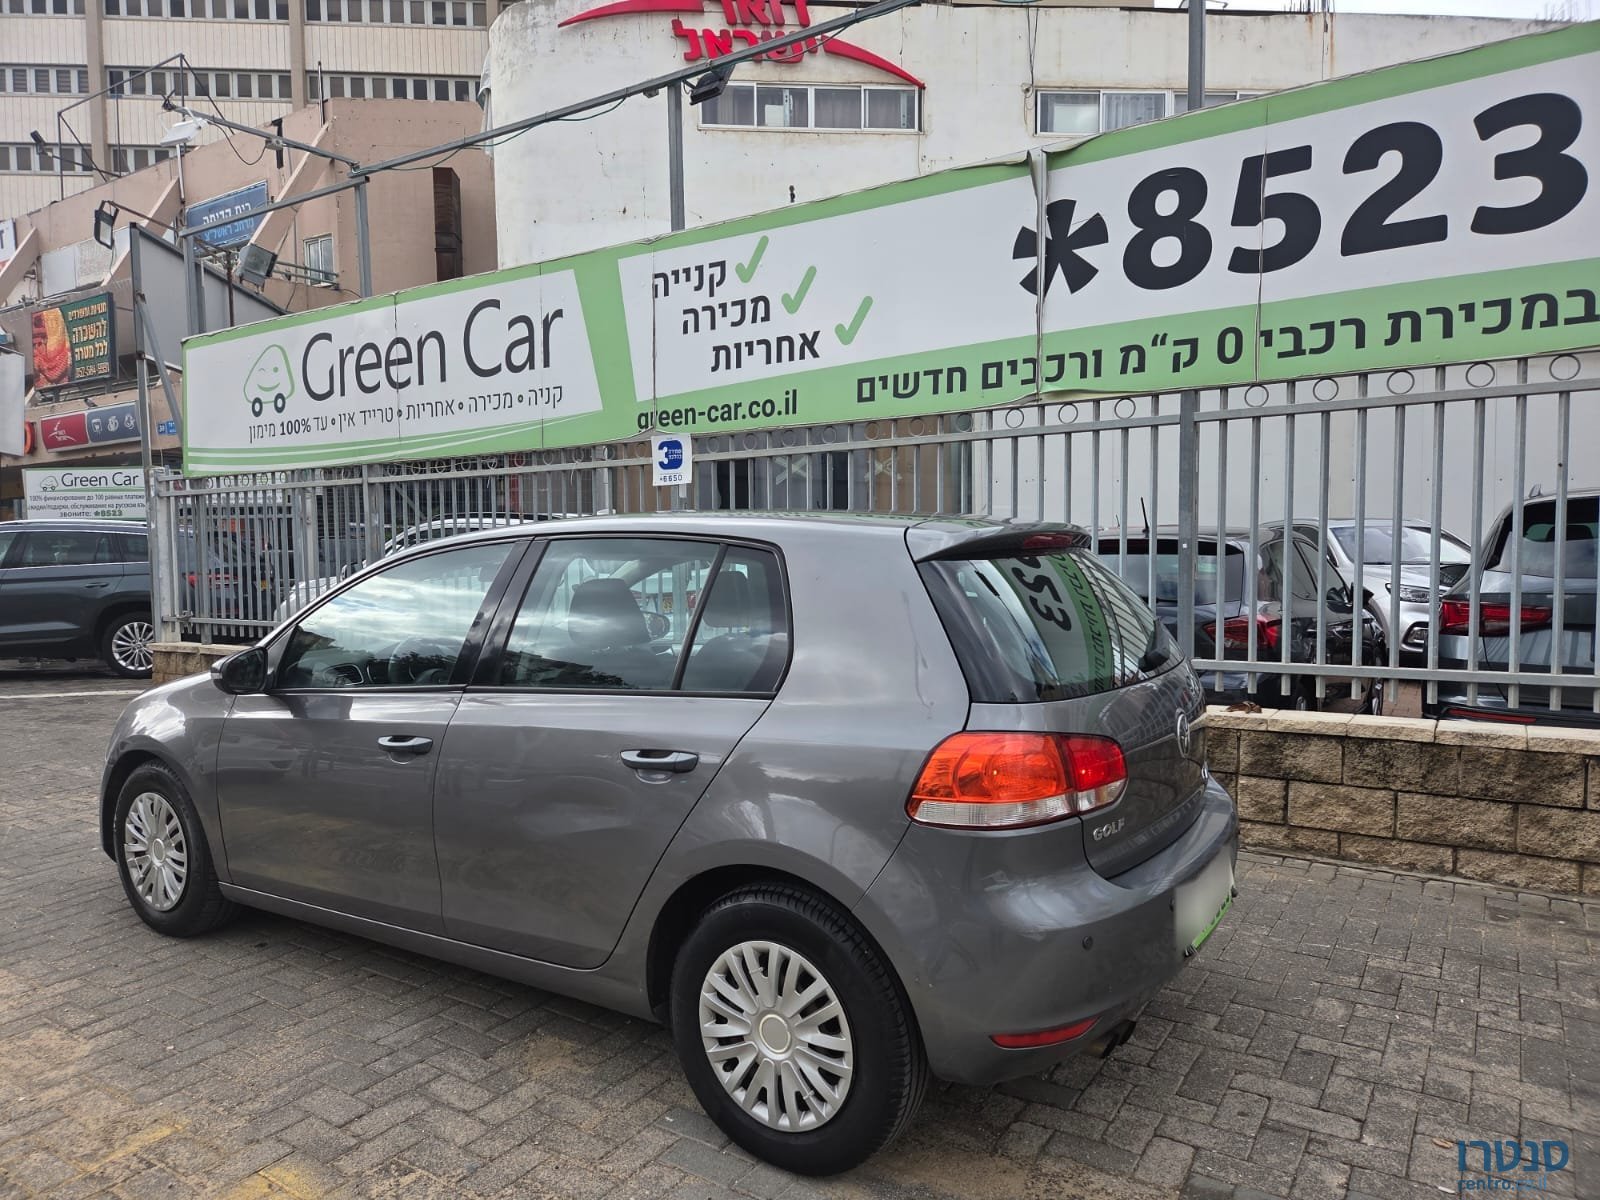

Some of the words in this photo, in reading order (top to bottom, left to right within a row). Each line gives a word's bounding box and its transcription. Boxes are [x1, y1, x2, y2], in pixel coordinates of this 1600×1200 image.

[672, 19, 818, 63] ישראל
[653, 260, 726, 298] קנייה
[682, 295, 770, 335] מכירה
[1384, 288, 1600, 346] במכירת
[72, 318, 107, 344] להשכרה
[1260, 317, 1366, 359] רכבי
[95, 339, 108, 357] לכל
[302, 330, 447, 402] Green
[463, 298, 563, 378] Car
[710, 330, 821, 373] אחריות
[1216, 326, 1243, 365] 0
[981, 349, 1103, 390] ורכבים
[528, 385, 563, 409] קניה
[857, 366, 967, 403] חדשים
[406, 399, 455, 420] אחריות
[468, 392, 513, 413] מכירה
[637, 389, 798, 432] green-car.co.il
[279, 418, 312, 436] 100%
[313, 415, 328, 431] עד
[338, 411, 356, 433] אין
[359, 407, 394, 426] טרייד
[249, 422, 276, 444] מימון
[61, 472, 108, 487] Green
[112, 471, 139, 486] Car
[1092, 817, 1125, 841] GOLF
